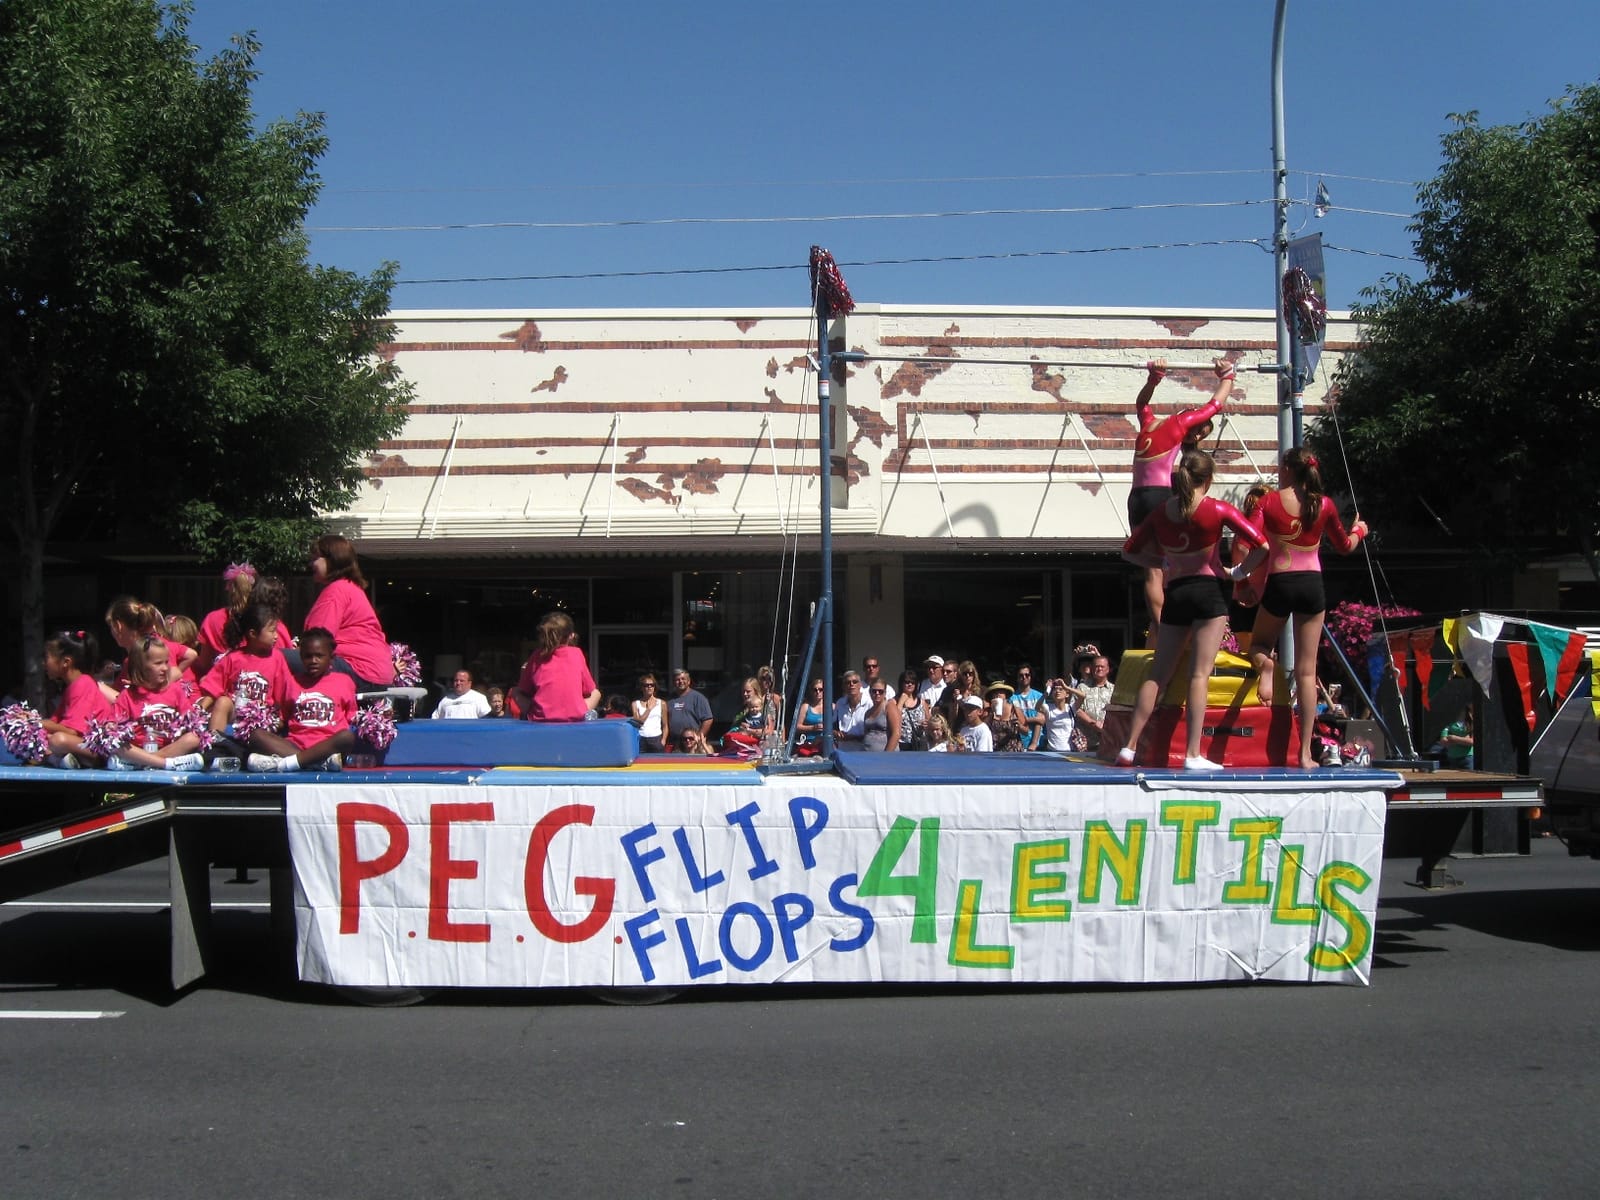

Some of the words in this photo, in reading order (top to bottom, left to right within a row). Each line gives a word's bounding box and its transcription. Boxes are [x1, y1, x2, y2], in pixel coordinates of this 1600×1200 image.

[336, 802, 623, 944] P.E.G.
[620, 796, 829, 904] FLIP
[856, 814, 941, 944] 4
[947, 800, 1373, 972] LENTILS
[623, 873, 875, 983] FLOPS
